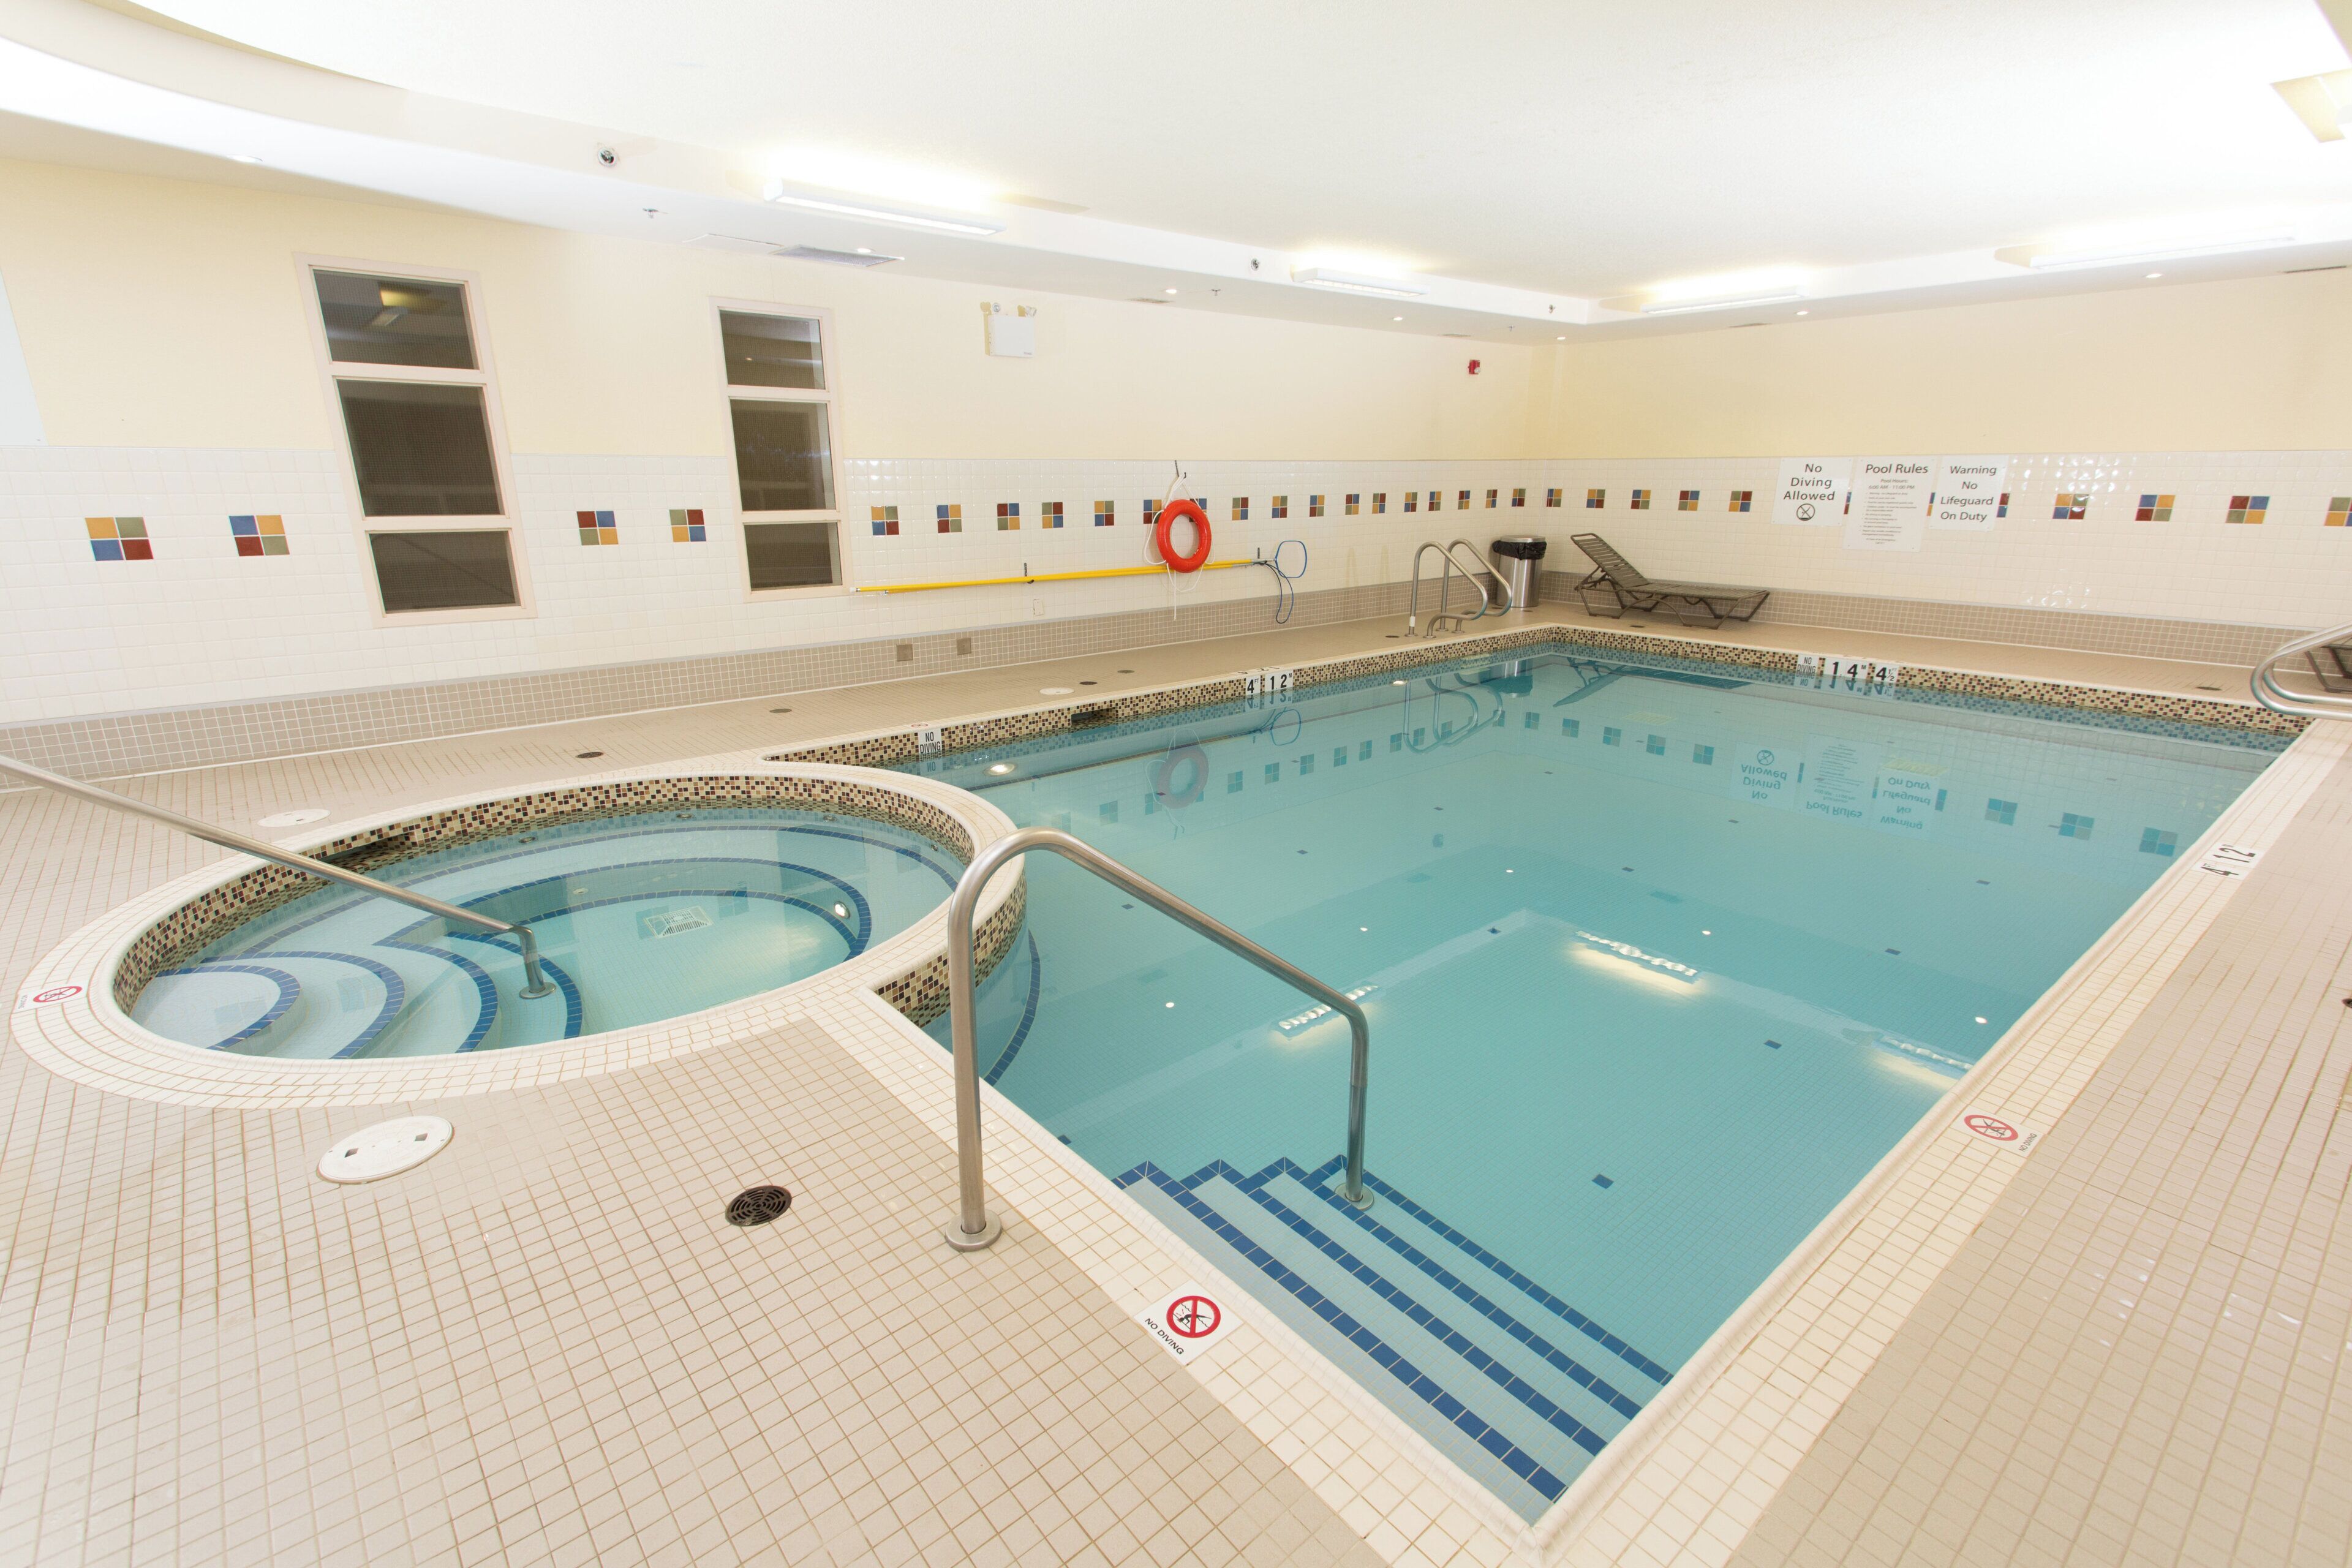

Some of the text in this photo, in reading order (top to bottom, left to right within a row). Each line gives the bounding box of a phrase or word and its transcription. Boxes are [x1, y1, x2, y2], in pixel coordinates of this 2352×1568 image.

[1804, 463, 1822, 473] No
[1865, 463, 1929, 473] Pool Rules
[1950, 466, 1997, 477] Warning
[1790, 477, 1832, 489] Diving
[1961, 481, 1978, 490] No
[1783, 491, 1835, 500] Allowed
[1940, 496, 1994, 507] Lifeguard
[1960, 511, 1988, 522] Duty
[1247, 679, 1254, 693] 4
[925, 731, 934, 742] NO
[920, 741, 941, 754] DIVING
[1144, 1318, 1185, 1355] NO DIVING
